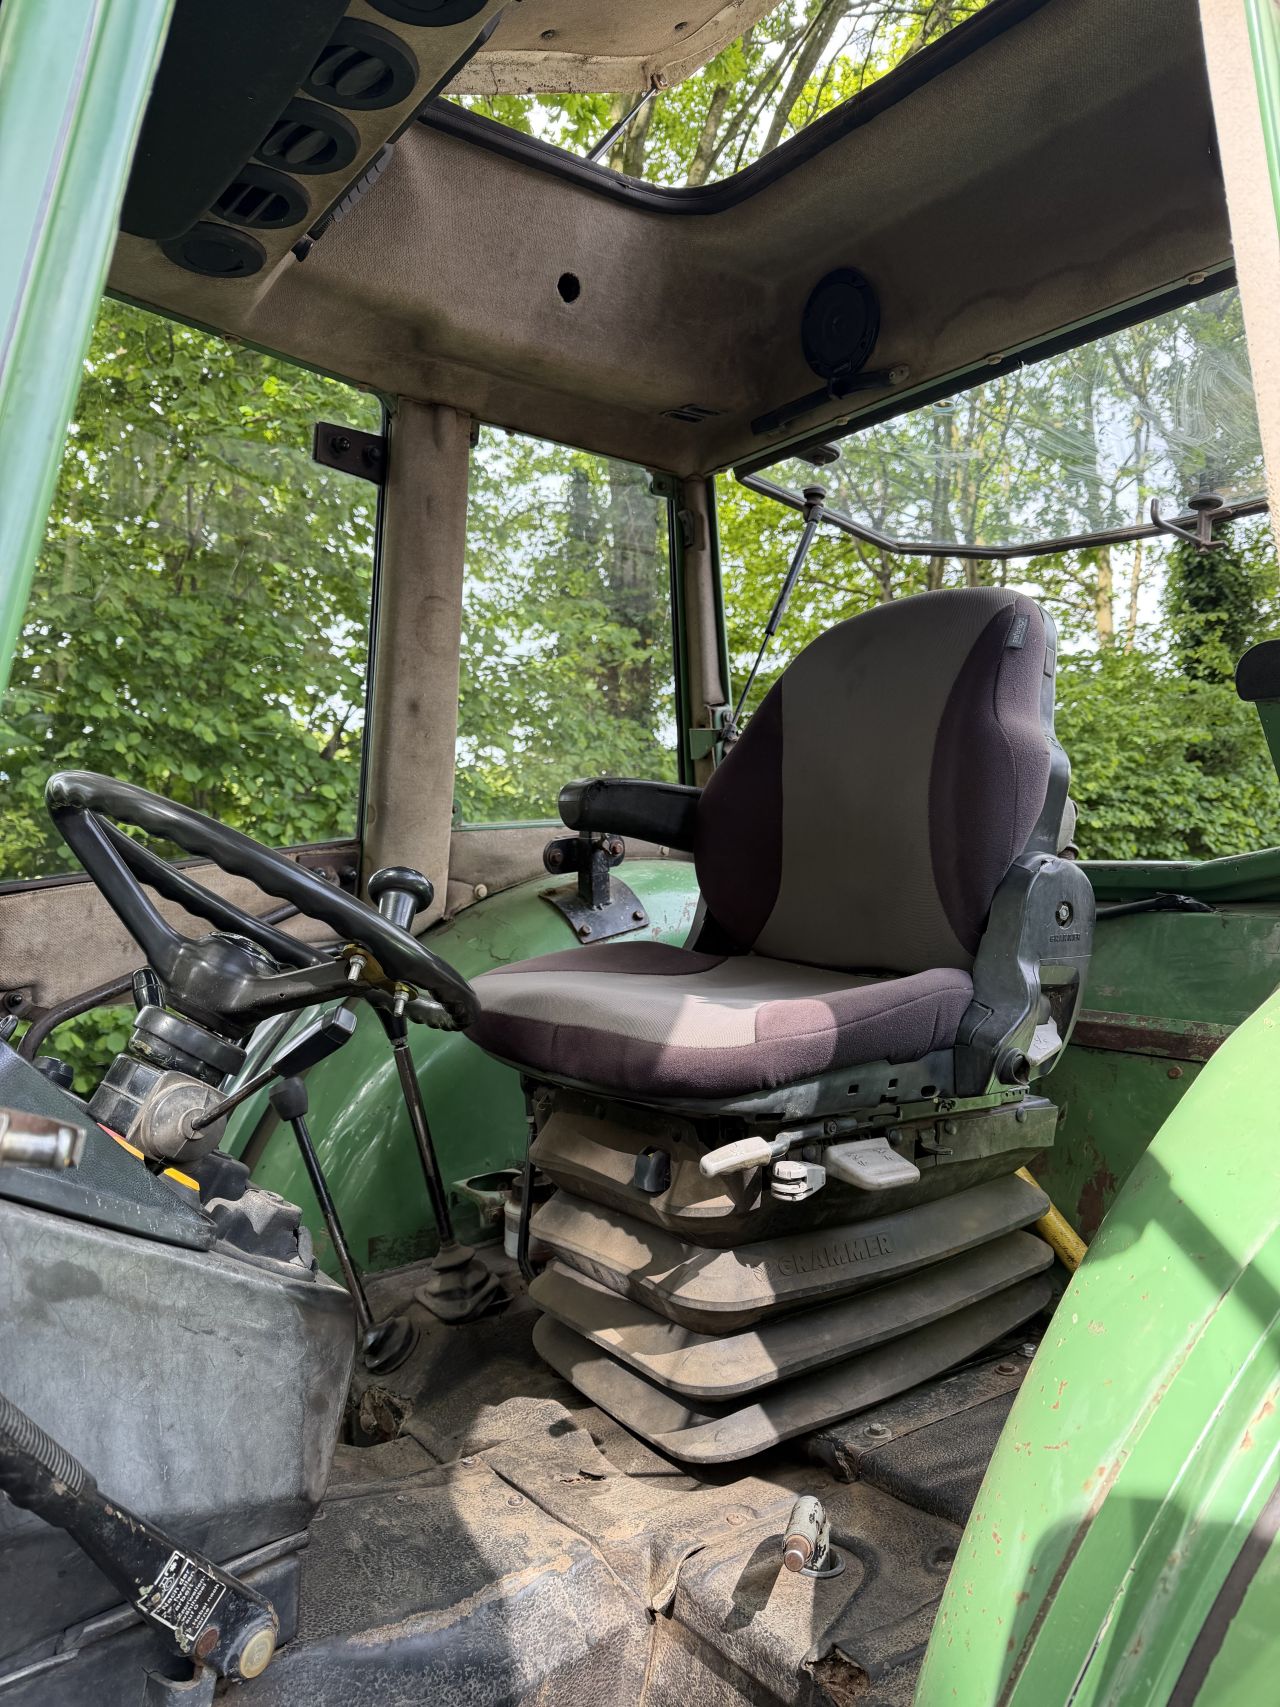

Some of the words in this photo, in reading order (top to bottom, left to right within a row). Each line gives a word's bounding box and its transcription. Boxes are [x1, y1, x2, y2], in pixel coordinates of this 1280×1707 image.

[778, 1234, 895, 1276] GRAMMER
[161, 1586, 180, 1611] Nach
[178, 1569, 190, 1585] der
[206, 1583, 220, 1602] nach
